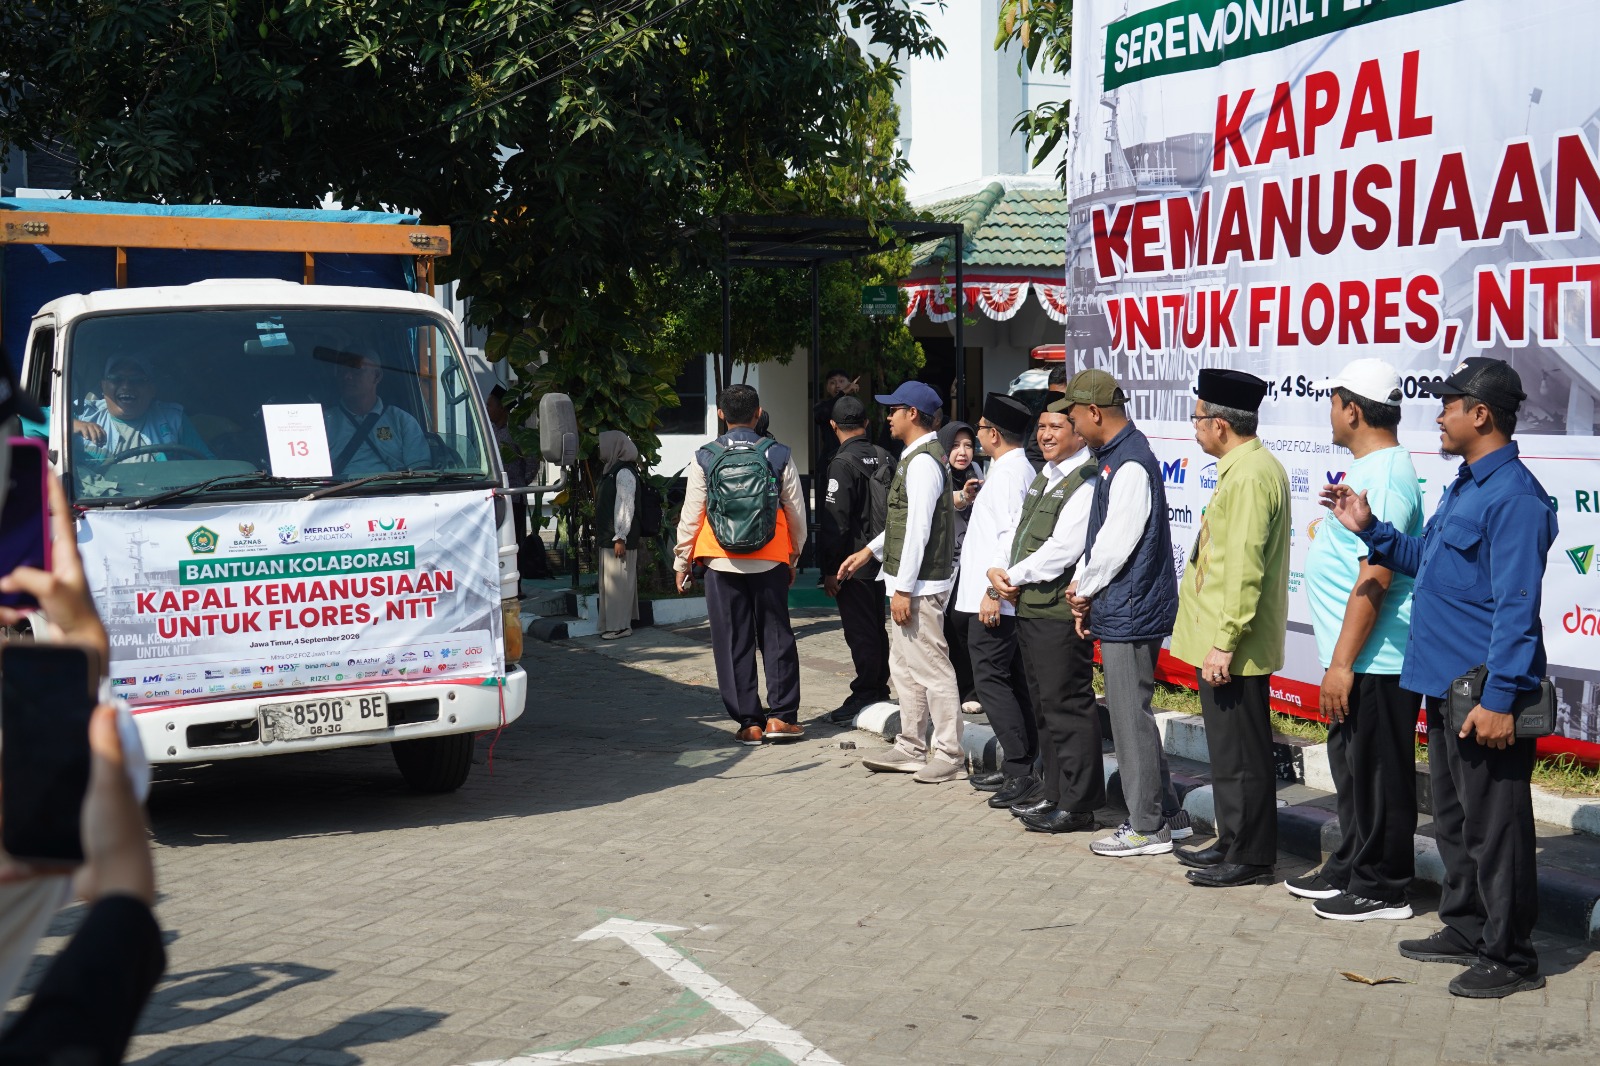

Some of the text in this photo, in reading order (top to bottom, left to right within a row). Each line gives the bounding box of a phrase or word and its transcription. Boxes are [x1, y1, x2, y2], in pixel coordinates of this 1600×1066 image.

[1213, 50, 1432, 171] KAPAL
[1092, 134, 1600, 278] KEMANUSIAAN
[1249, 274, 1458, 354] FLORES,
[1477, 263, 1600, 342] NTT
[1281, 375, 1293, 397] 4
[288, 440, 309, 457] 13
[1276, 440, 1293, 452] OPZ
[1294, 440, 1311, 453] FOZ
[1311, 441, 1330, 454] Jawa
[1158, 457, 1189, 484] Mi
[1291, 476, 1309, 485] DEWAN
[304, 525, 345, 534] MERATUS
[304, 532, 353, 541] FOUNDATION
[186, 550, 409, 580] BANTUAN KOLABORASI
[136, 570, 453, 614] KAPAL KEMANUSIAAN
[158, 597, 437, 639] UNTUK FLORES, NTT
[110, 634, 145, 647] KAPAL
[250, 640, 269, 648] Jawa
[300, 634, 340, 644] September
[137, 644, 191, 659] UNTUK NTT
[310, 674, 330, 683] RIZKI
[294, 701, 344, 726] 8590
[359, 696, 384, 719] BE
